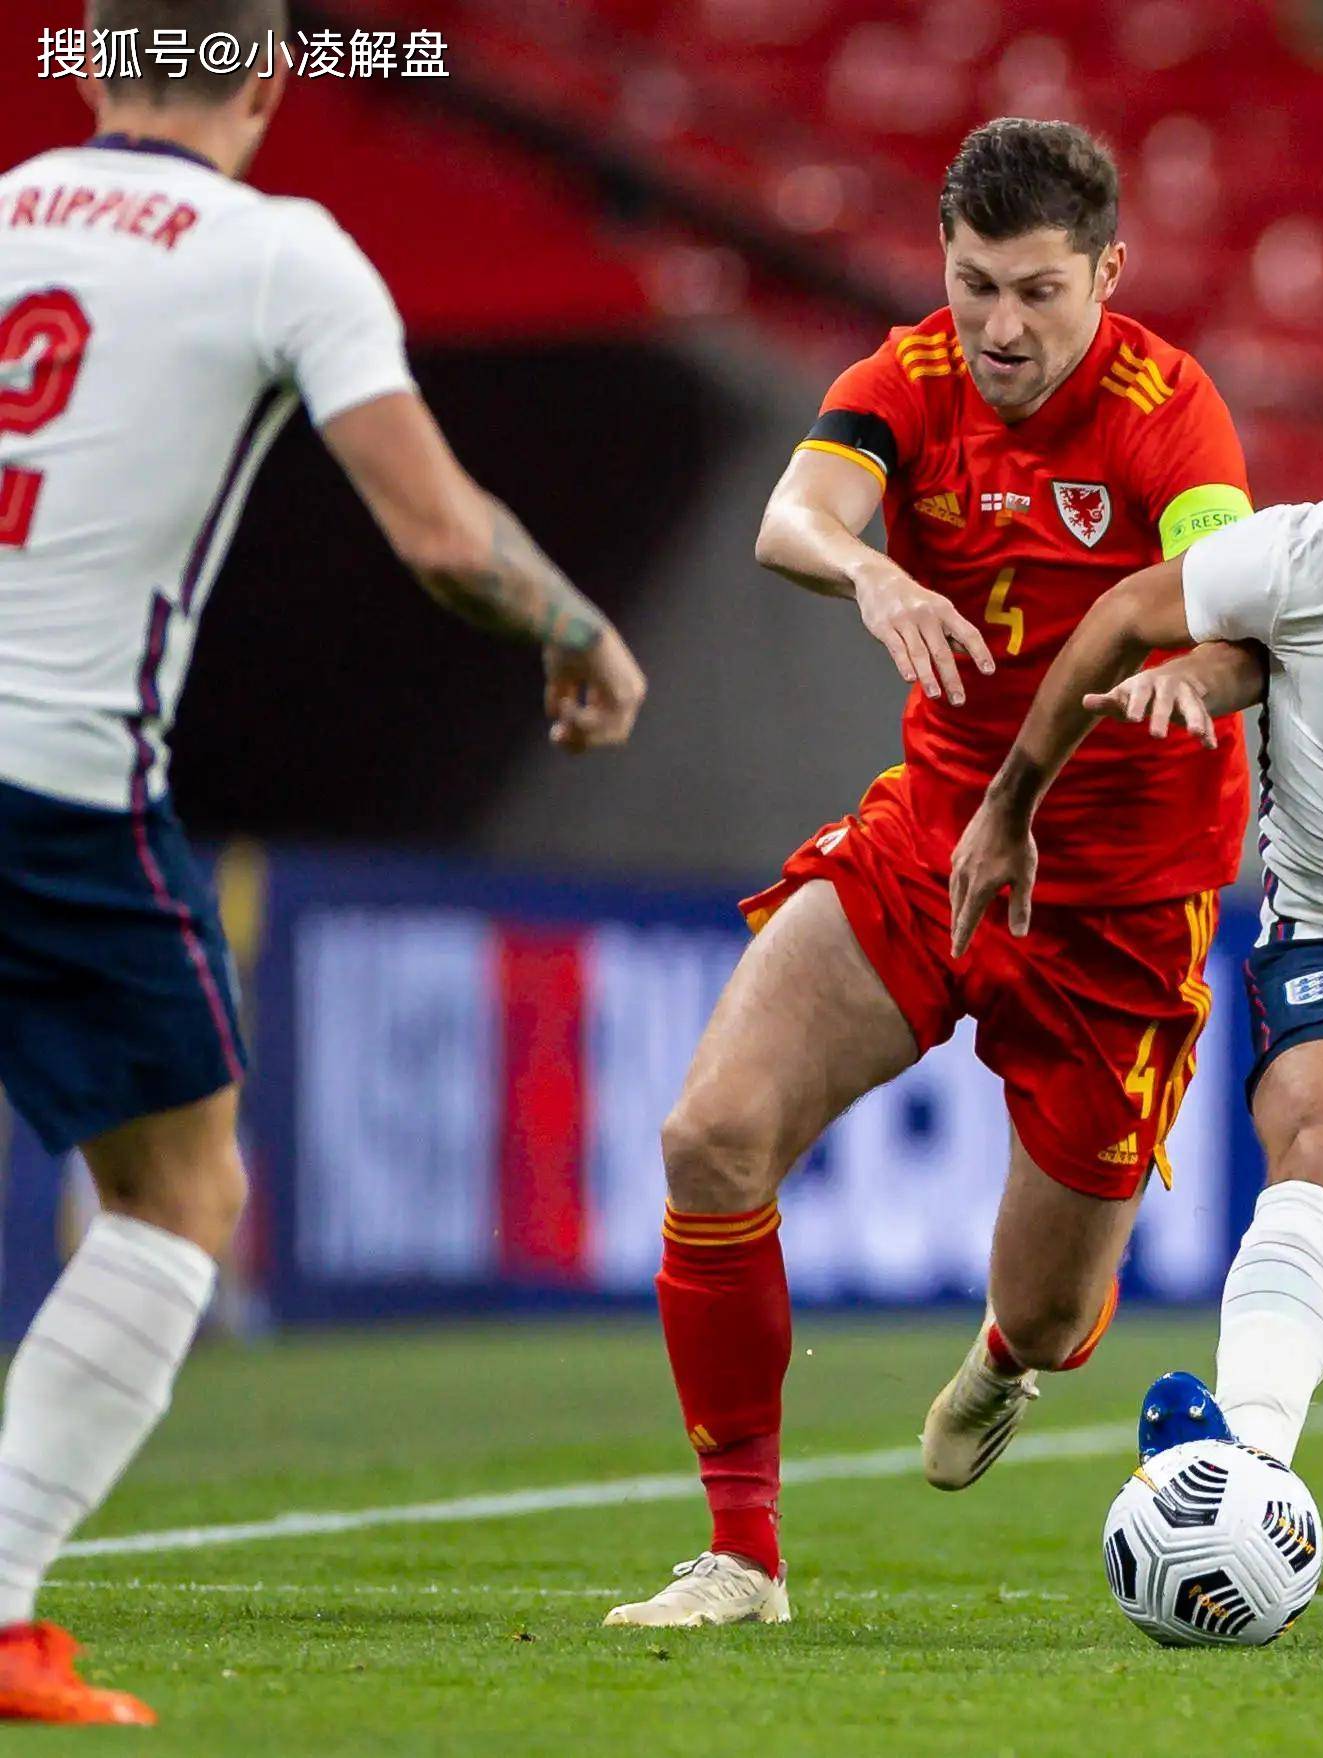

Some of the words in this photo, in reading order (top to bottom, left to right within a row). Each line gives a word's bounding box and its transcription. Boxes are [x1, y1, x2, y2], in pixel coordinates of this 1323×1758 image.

[0, 184, 197, 251] RIPPIER
[1191, 513, 1237, 530] RESP
[985, 567, 1023, 656] 4
[1125, 1021, 1159, 1119] 4
